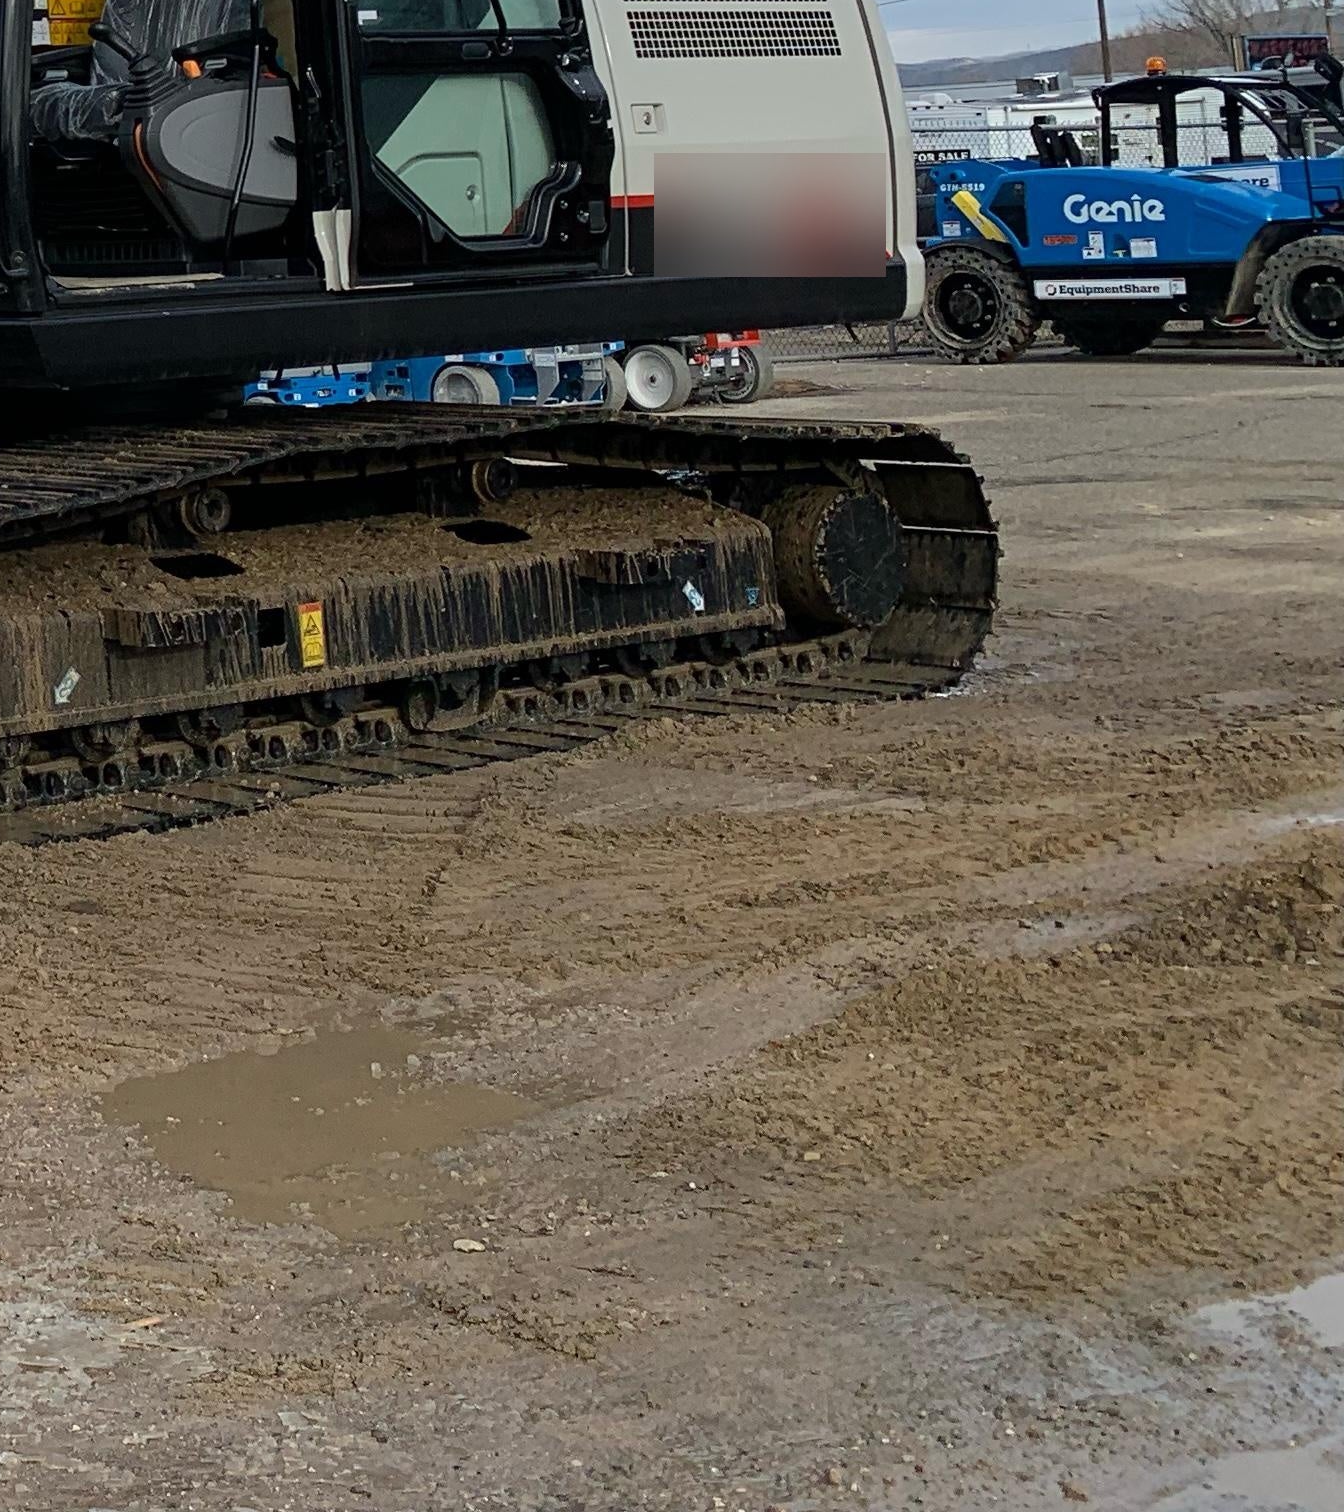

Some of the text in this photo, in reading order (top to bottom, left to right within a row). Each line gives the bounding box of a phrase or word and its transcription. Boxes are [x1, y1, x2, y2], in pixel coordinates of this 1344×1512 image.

[938, 151, 969, 161] SALE
[1063, 193, 1165, 224] Genie
[1059, 283, 1161, 297] EquipmentShare
